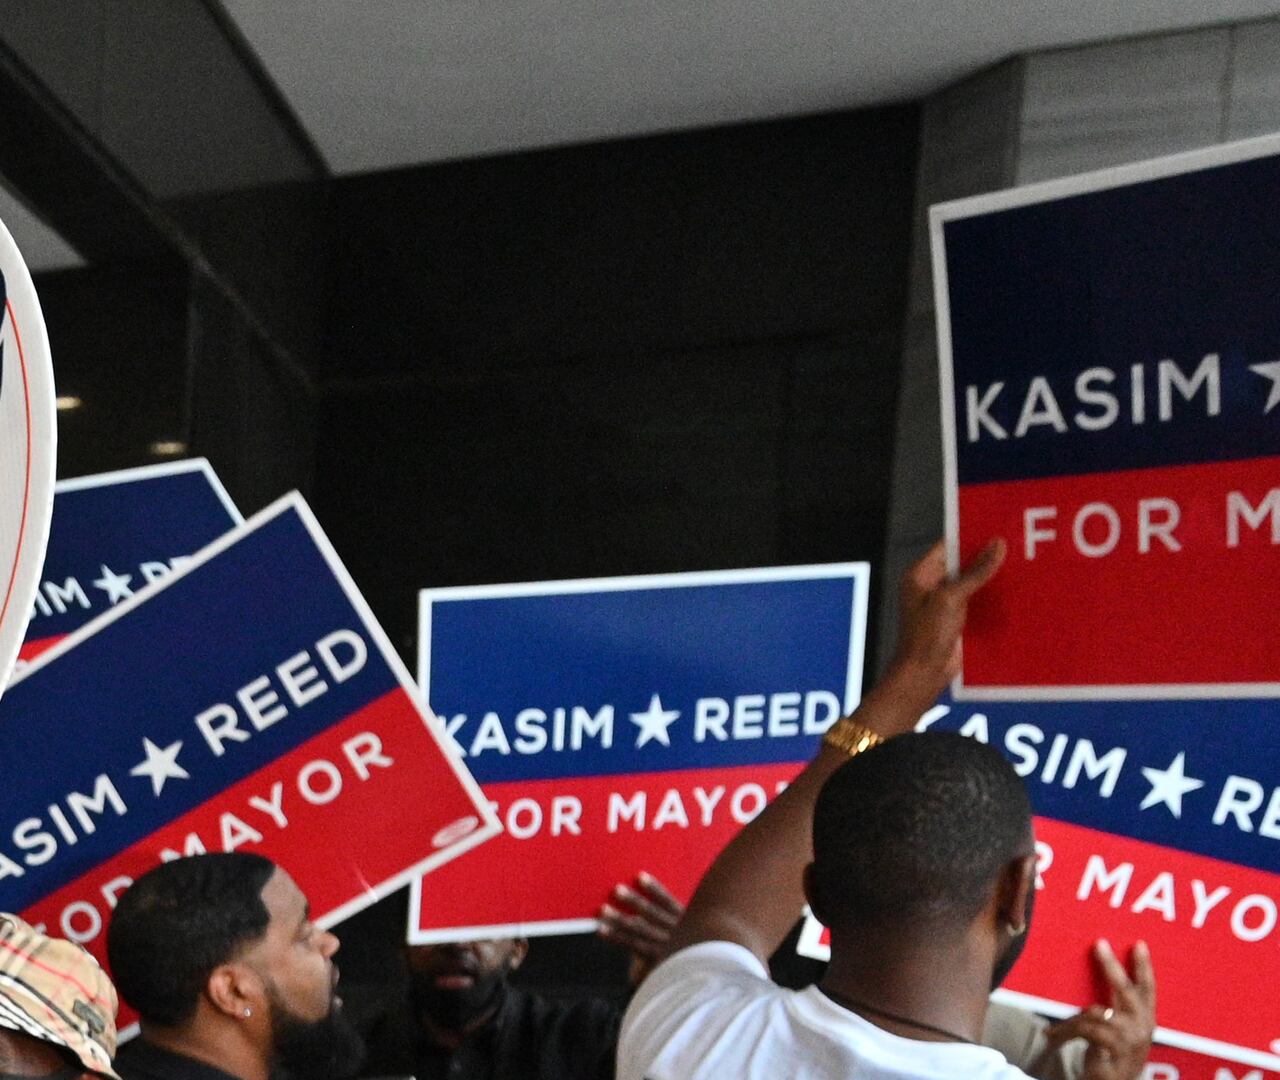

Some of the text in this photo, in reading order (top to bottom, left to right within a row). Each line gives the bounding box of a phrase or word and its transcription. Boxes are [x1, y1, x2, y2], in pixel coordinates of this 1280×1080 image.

[965, 353, 1221, 444] KASIM
[1023, 497, 1181, 561] FOR
[195, 629, 369, 757] REED
[438, 690, 839, 758] KASIM REED
[607, 781, 790, 833] MAYO
[1211, 774, 1280, 841] RE
[1077, 855, 1278, 942] MAYO
